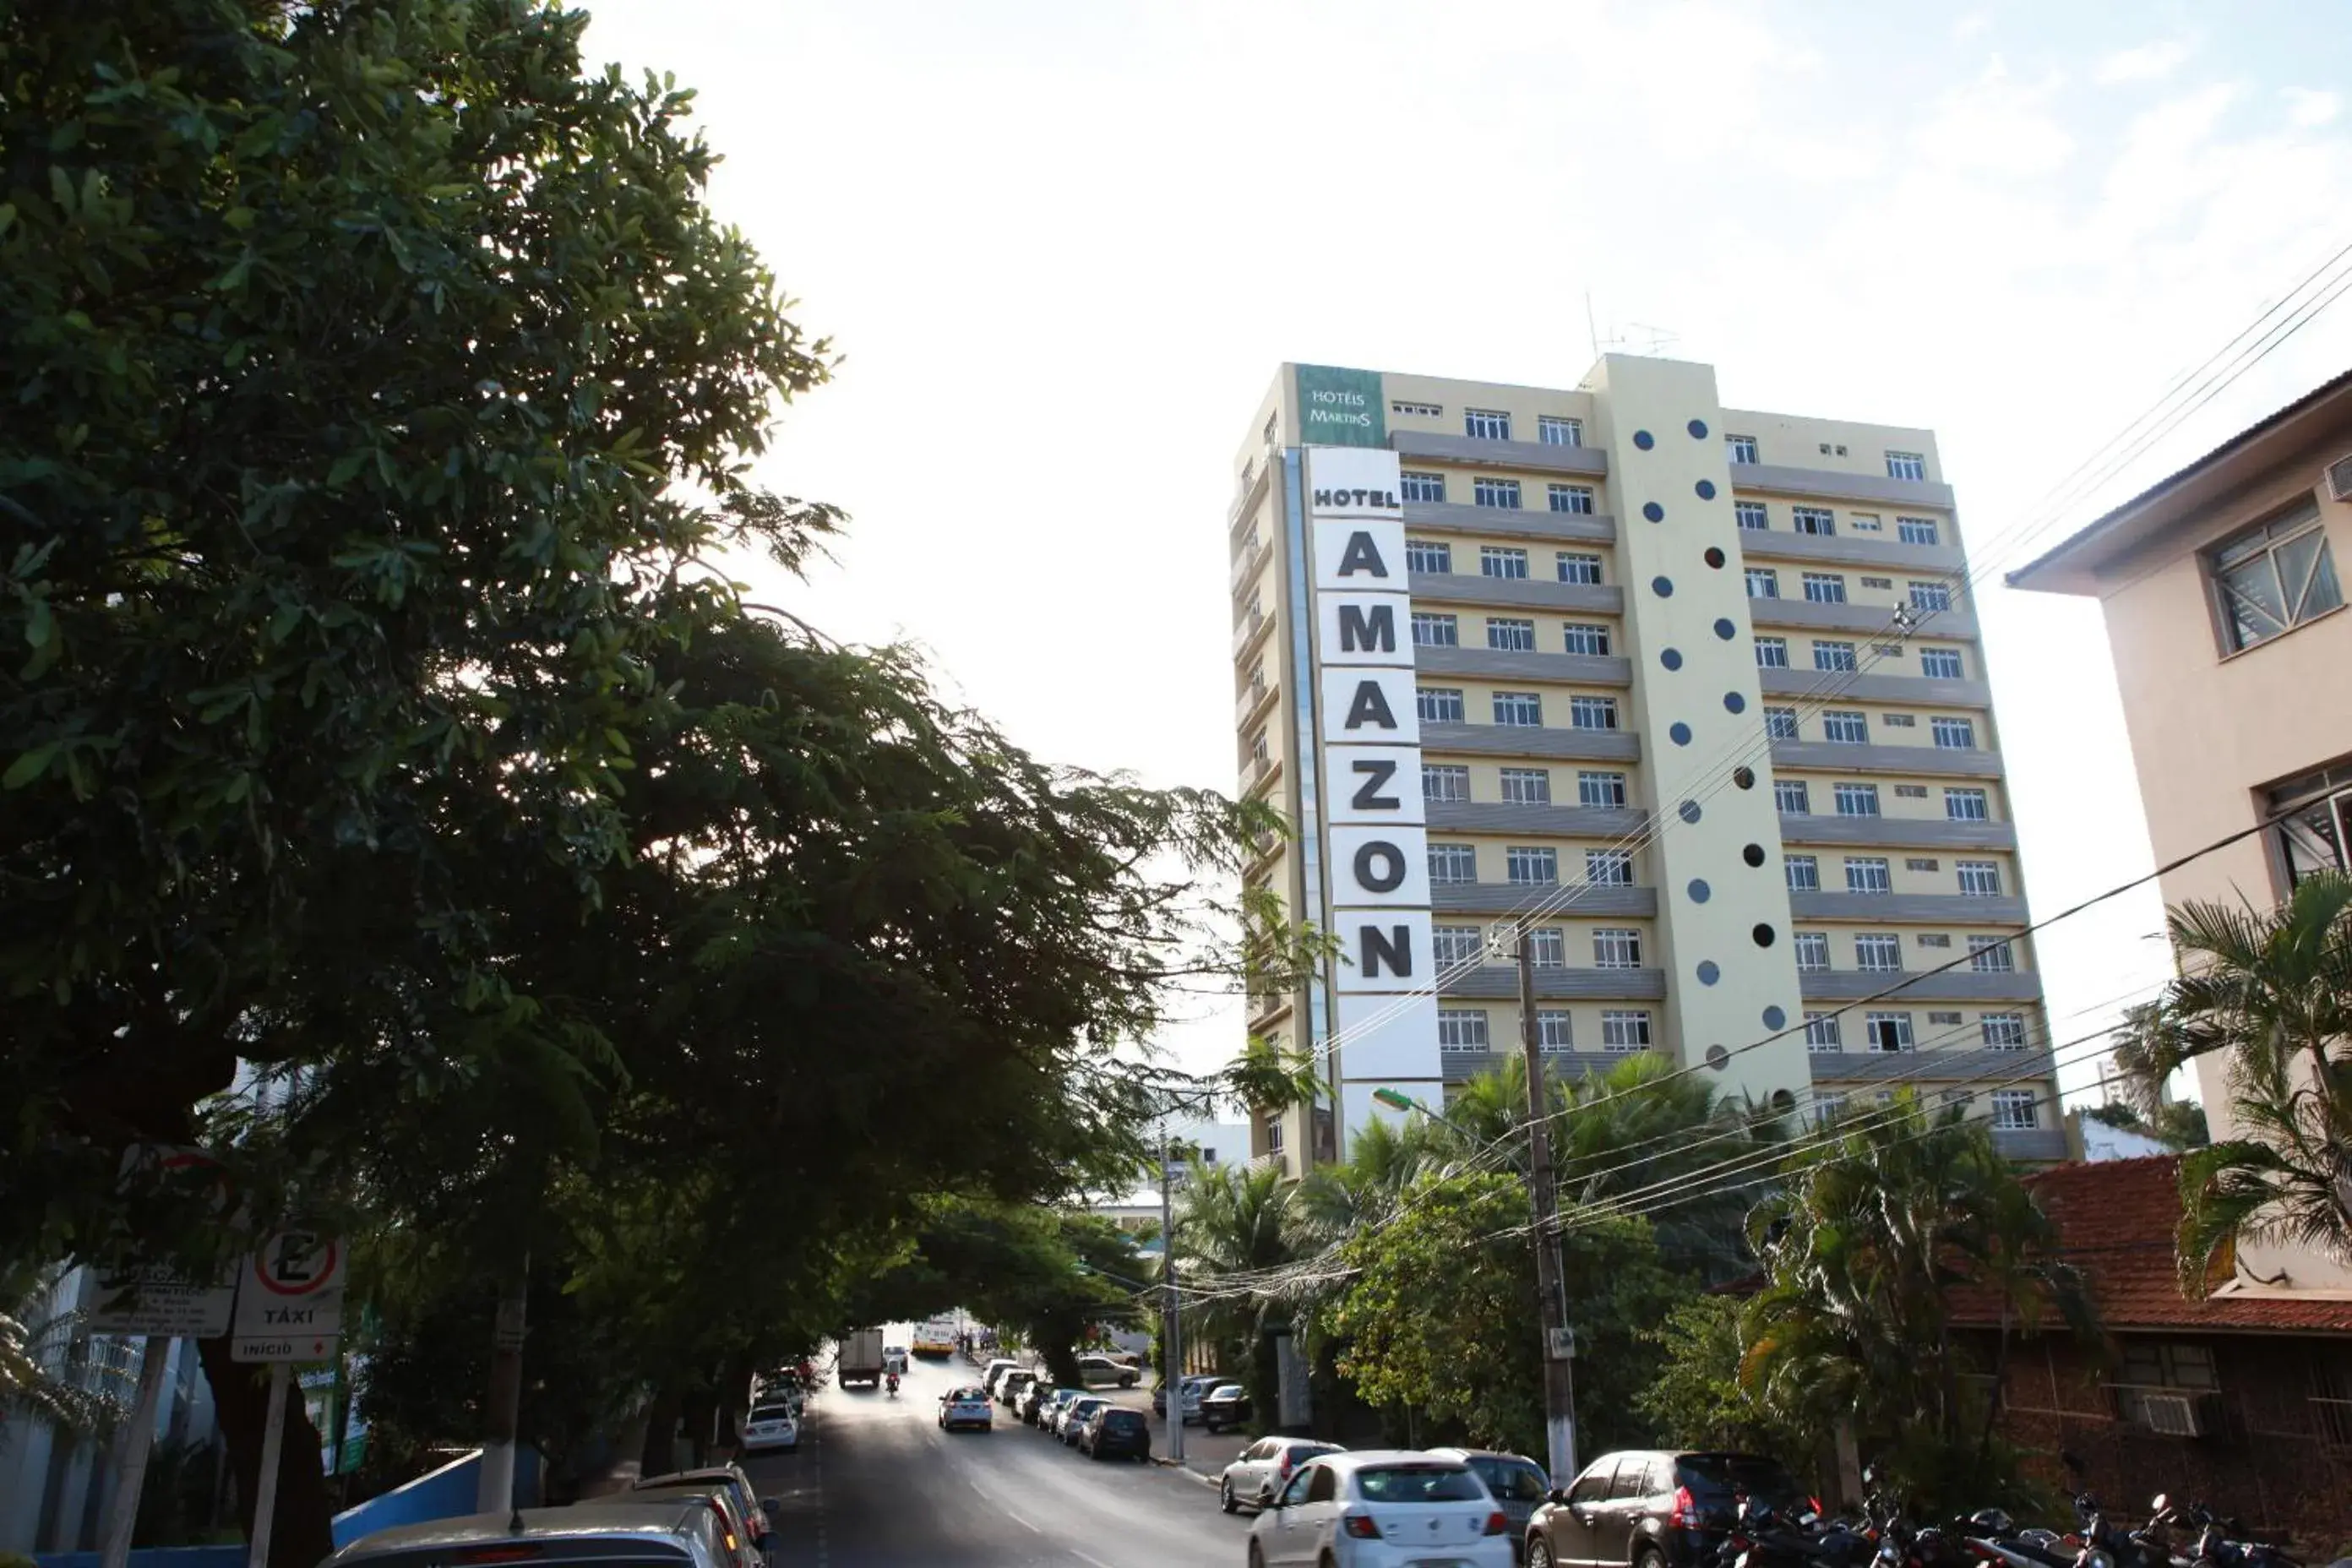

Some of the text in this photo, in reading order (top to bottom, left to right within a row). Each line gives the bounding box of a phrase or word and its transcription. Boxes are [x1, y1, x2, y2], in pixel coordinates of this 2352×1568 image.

[1315, 489, 1400, 509] HOTEL
[1337, 531, 1413, 978] AMAZON
[277, 1233, 315, 1281] E
[264, 1304, 313, 1325] TÁXI
